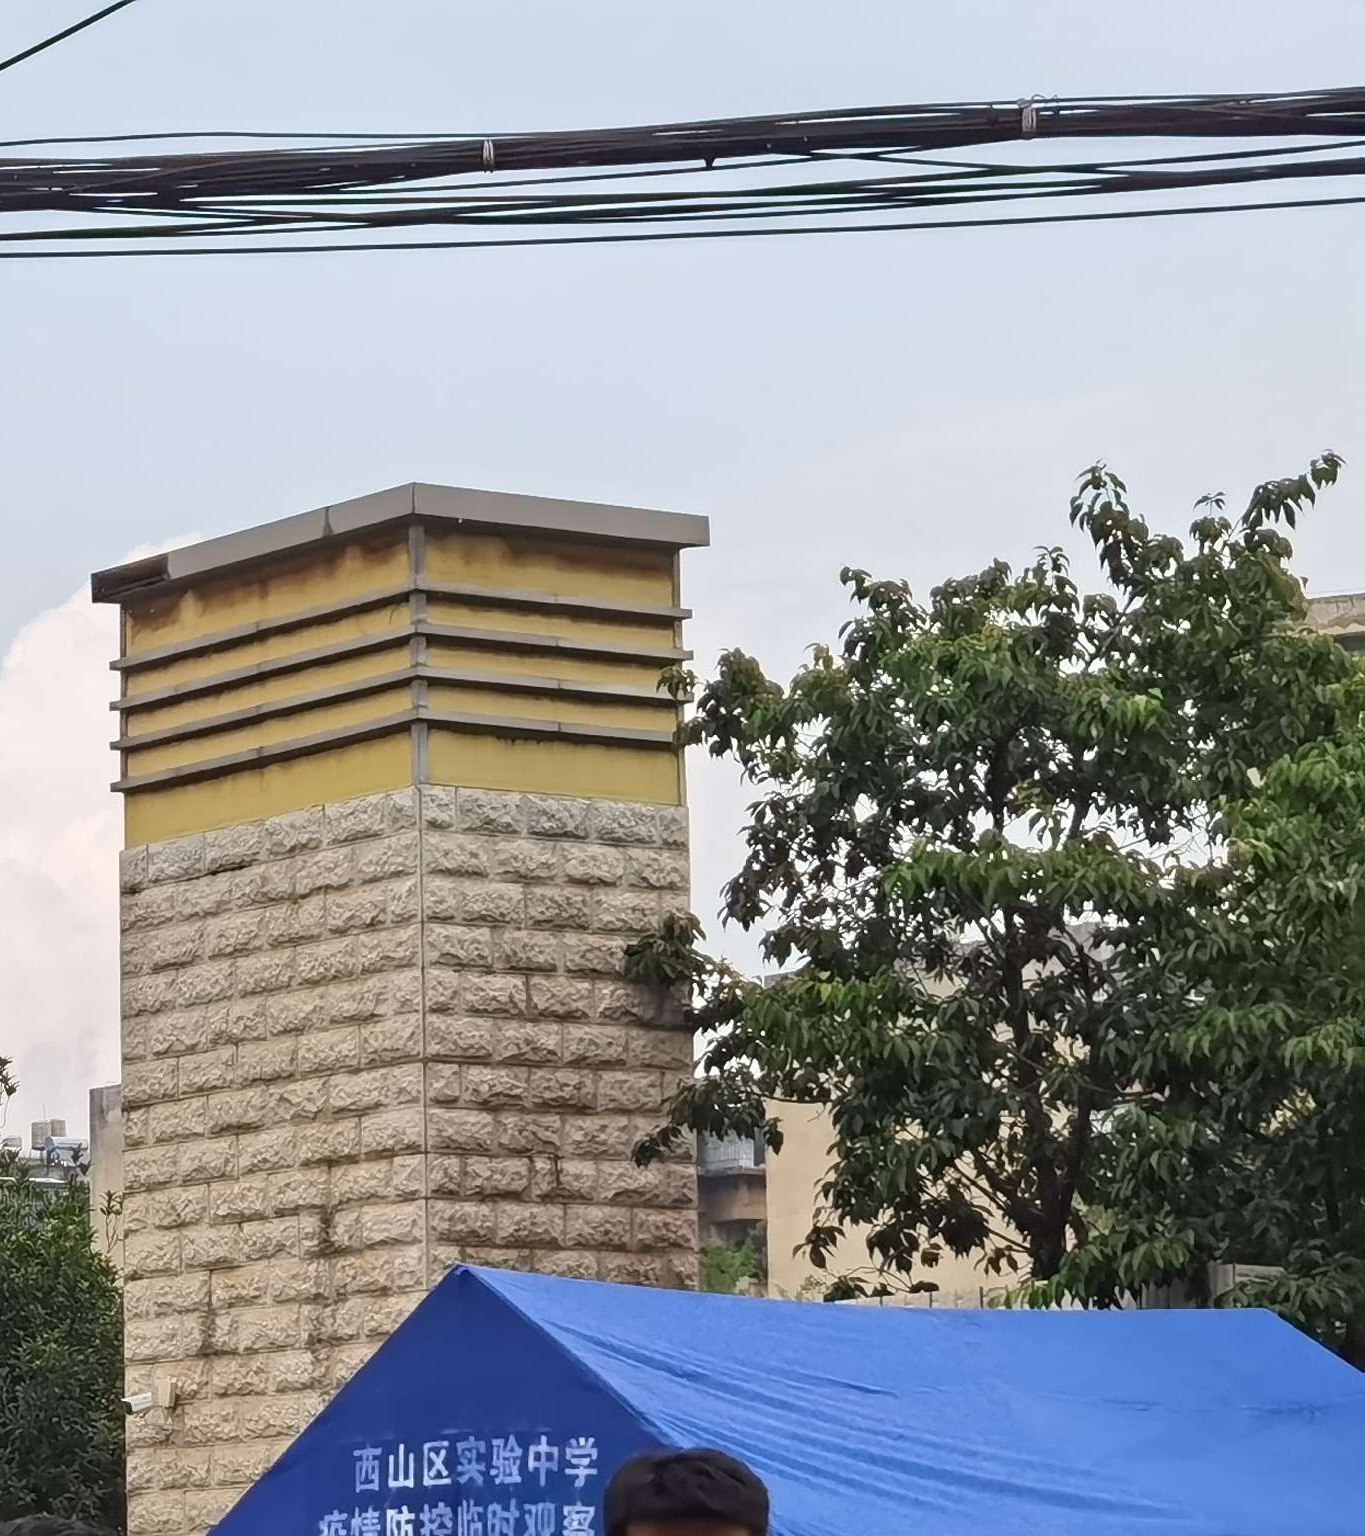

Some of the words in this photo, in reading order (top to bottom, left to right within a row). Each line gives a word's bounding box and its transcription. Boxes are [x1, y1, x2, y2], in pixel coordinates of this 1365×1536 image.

[353, 1434, 599, 1494] 西山区实验中学
